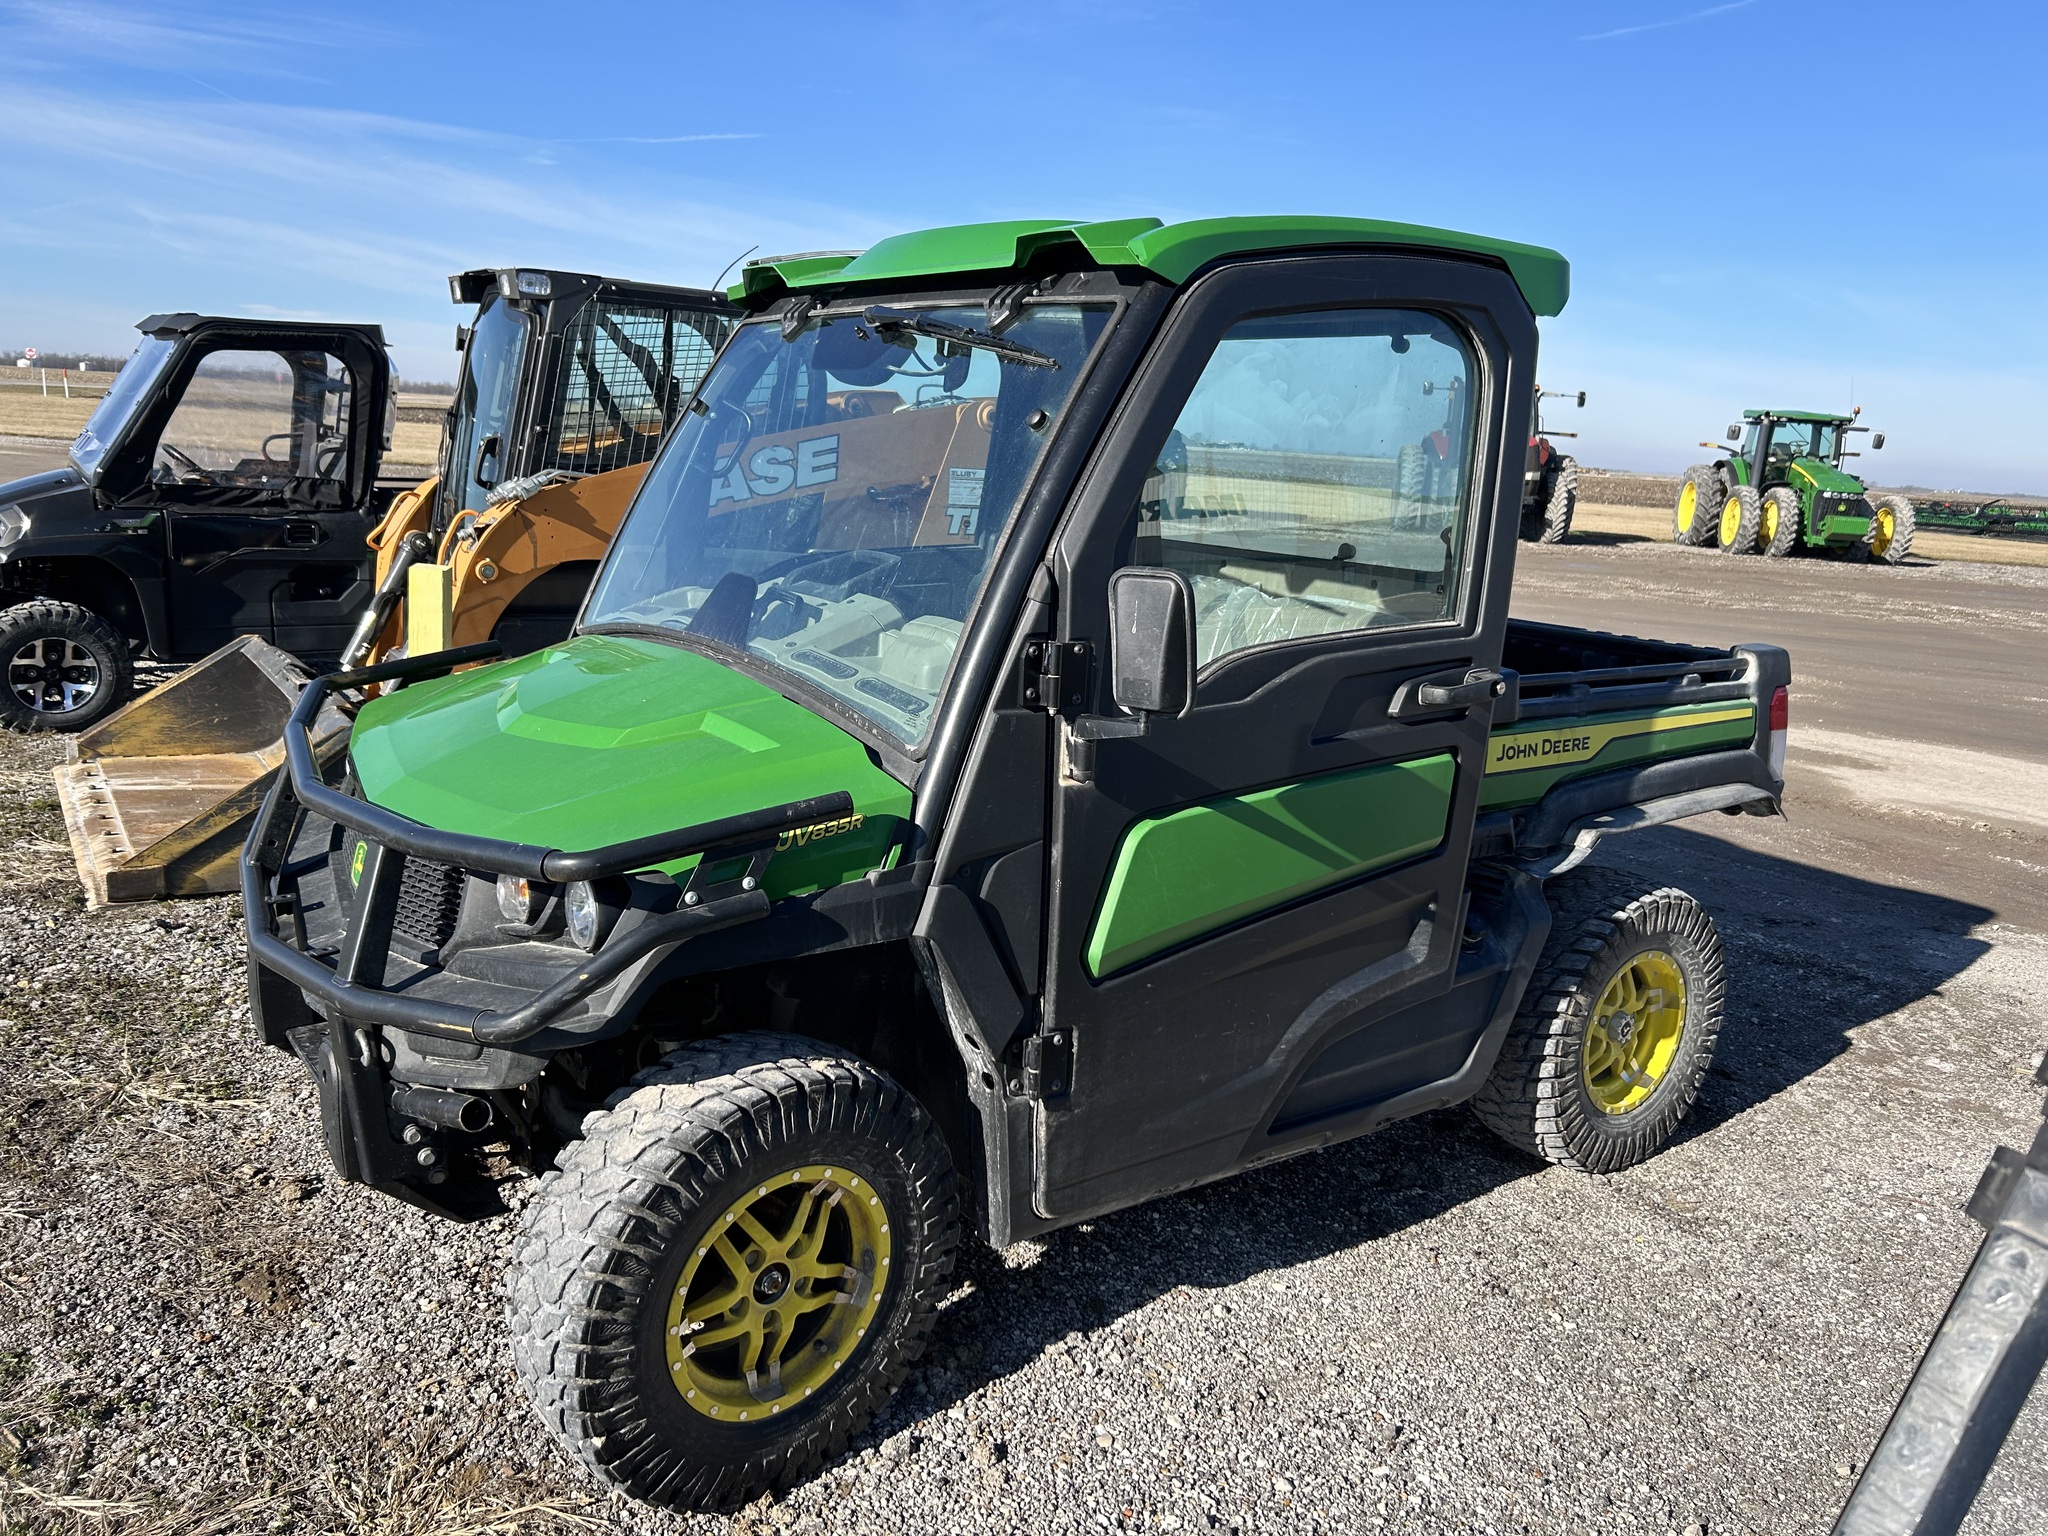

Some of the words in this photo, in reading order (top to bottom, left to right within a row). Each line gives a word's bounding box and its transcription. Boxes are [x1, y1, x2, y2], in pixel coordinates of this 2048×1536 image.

[709, 433, 840, 507] ASE
[1496, 742, 1538, 762] JOHN
[1542, 736, 1591, 756] DEERE
[775, 813, 865, 852] UV835R
